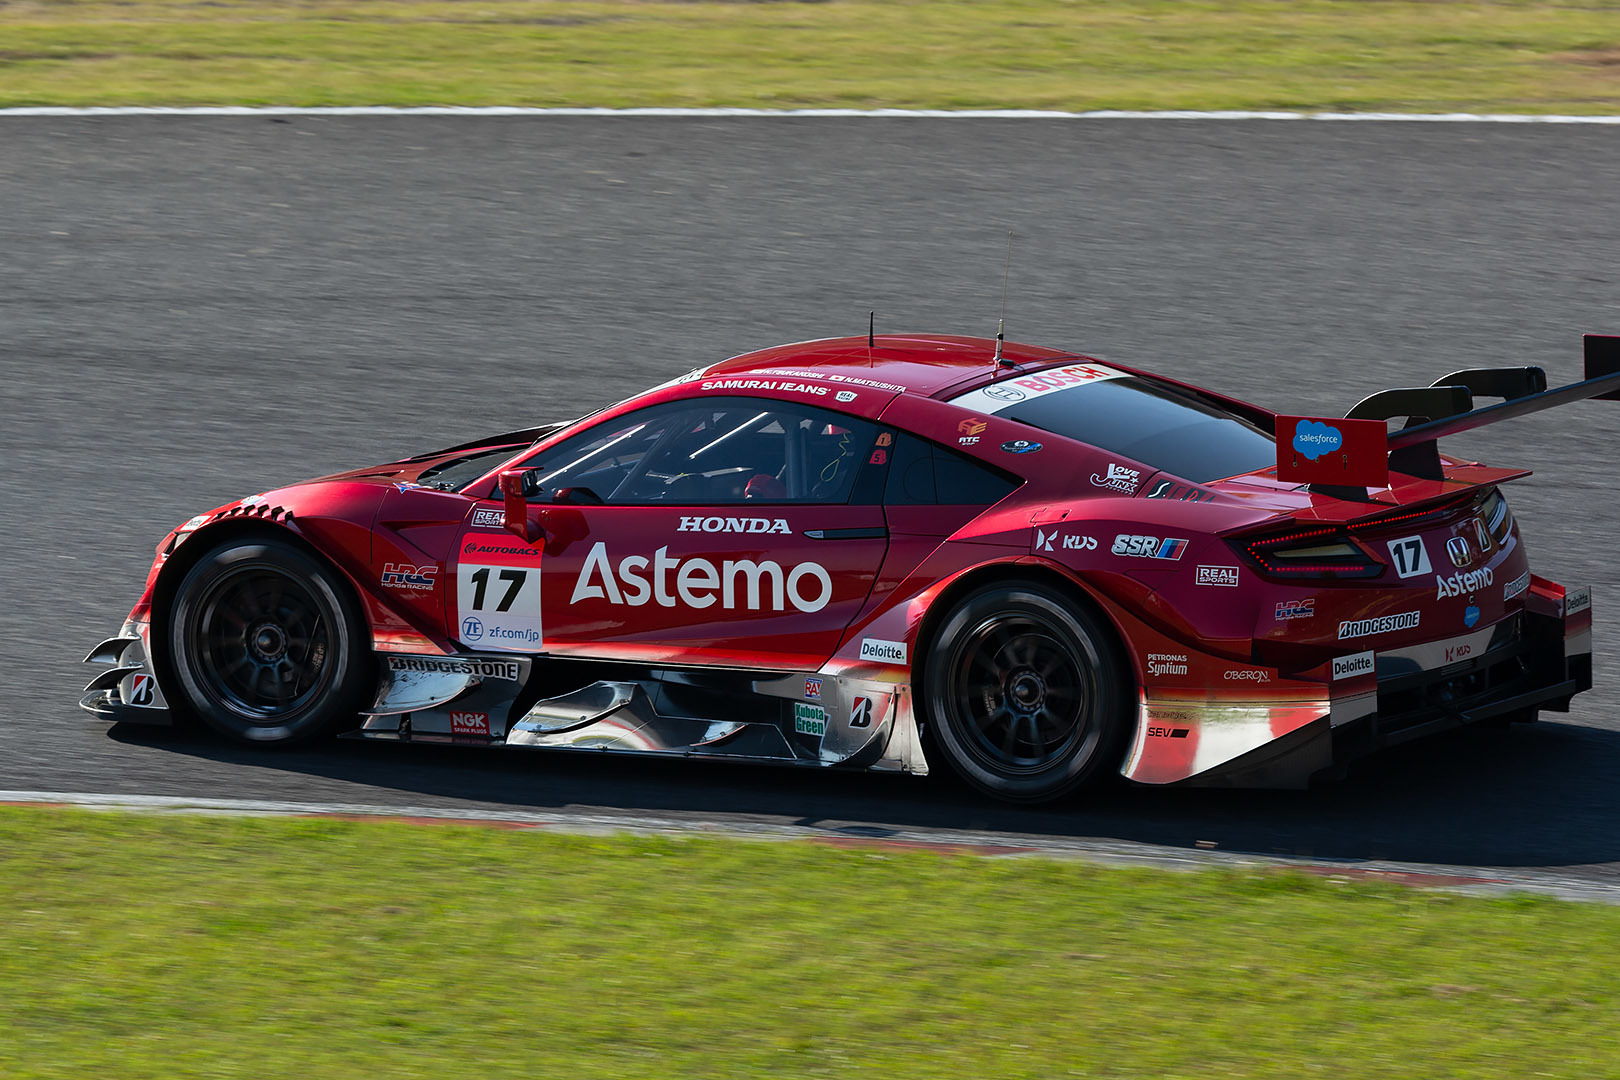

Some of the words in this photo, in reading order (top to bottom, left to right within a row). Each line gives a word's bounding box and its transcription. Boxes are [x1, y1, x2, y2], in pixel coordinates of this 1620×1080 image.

[701, 380, 777, 391] SAMURAI
[777, 382, 827, 396] JEANS
[1013, 366, 1110, 392] BOSCH
[1299, 433, 1338, 444] salesforce
[676, 516, 793, 535] HONDA
[477, 545, 540, 556] AUTOBACS
[1111, 534, 1160, 558] SSR
[1393, 540, 1421, 574] 17
[381, 562, 439, 586] HRC
[569, 541, 833, 613] Astemo
[1199, 568, 1239, 579] REAL
[1199, 576, 1236, 584] SPORTS
[470, 568, 528, 612] 17
[1436, 567, 1494, 601] Astemo
[464, 621, 481, 634] ZF
[489, 626, 539, 642] zf.com/jp
[1338, 611, 1421, 640] BRIDGESTONE
[1147, 653, 1188, 662] PETRONAS
[387, 656, 519, 681] BRIDGESTONE
[1147, 661, 1188, 676] Syntium
[1224, 670, 1269, 683] OBERON
[452, 712, 487, 728] NGK
[795, 703, 824, 721] Kubota
[796, 716, 824, 735] Green
[1147, 727, 1171, 738] SEV
